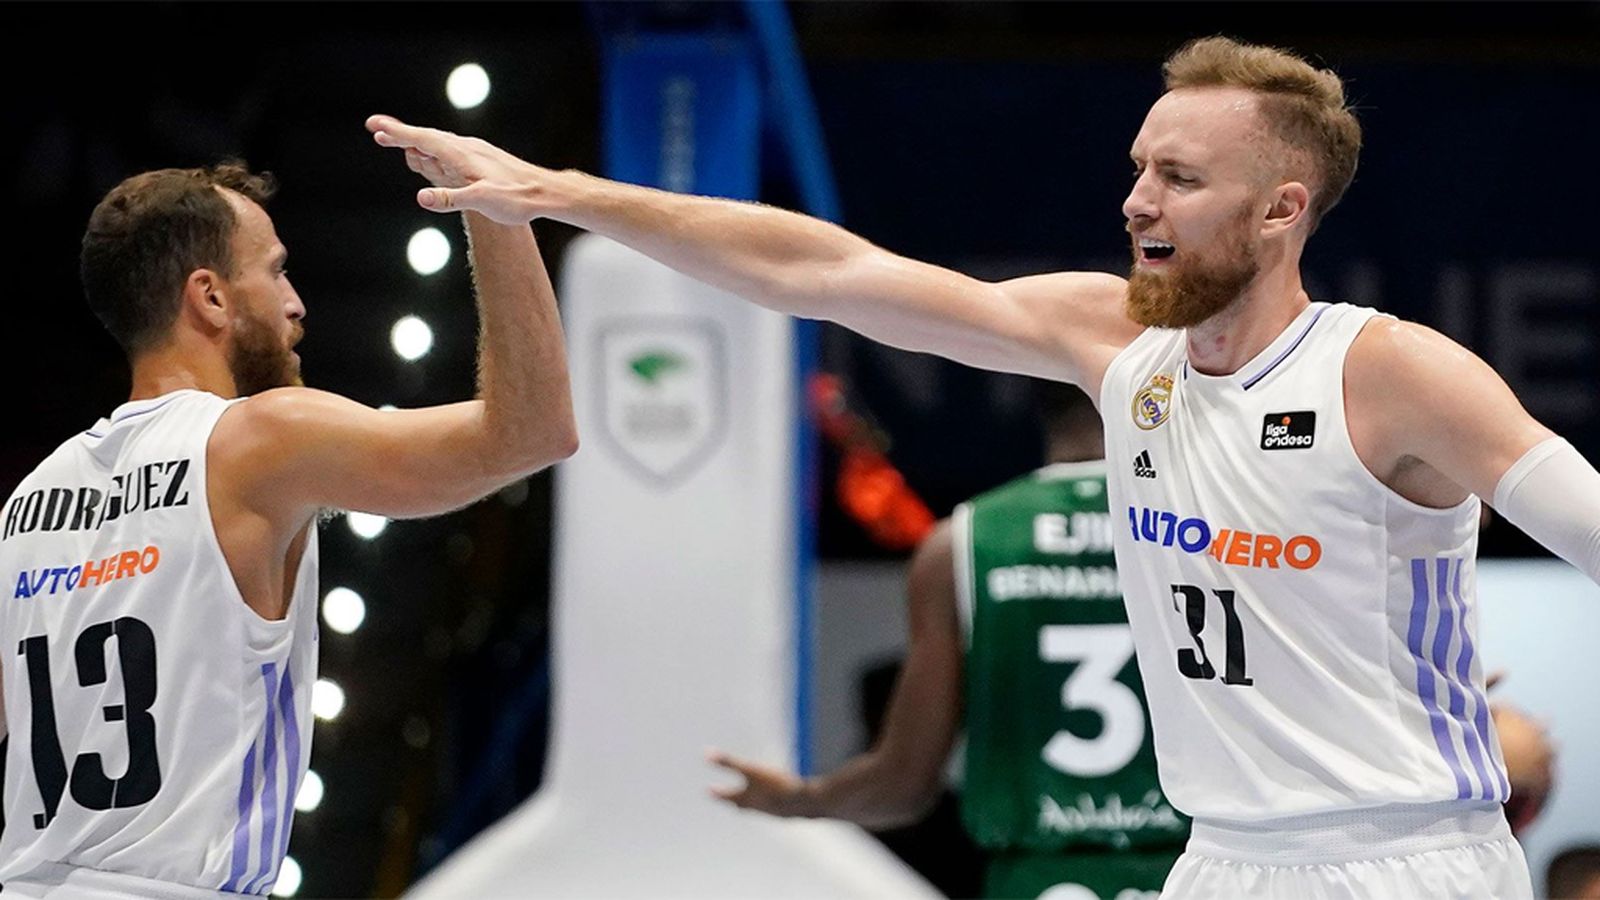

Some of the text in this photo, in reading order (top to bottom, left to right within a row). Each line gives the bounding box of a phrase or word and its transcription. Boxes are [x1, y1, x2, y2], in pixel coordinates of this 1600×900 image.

[1264, 434, 1312, 447] endesa
[1266, 423, 1288, 437] liga
[14, 546, 160, 599] AUTOHERO
[1170, 584, 1254, 686] 31
[18, 616, 162, 830] 13
[1038, 623, 1146, 778] 3
